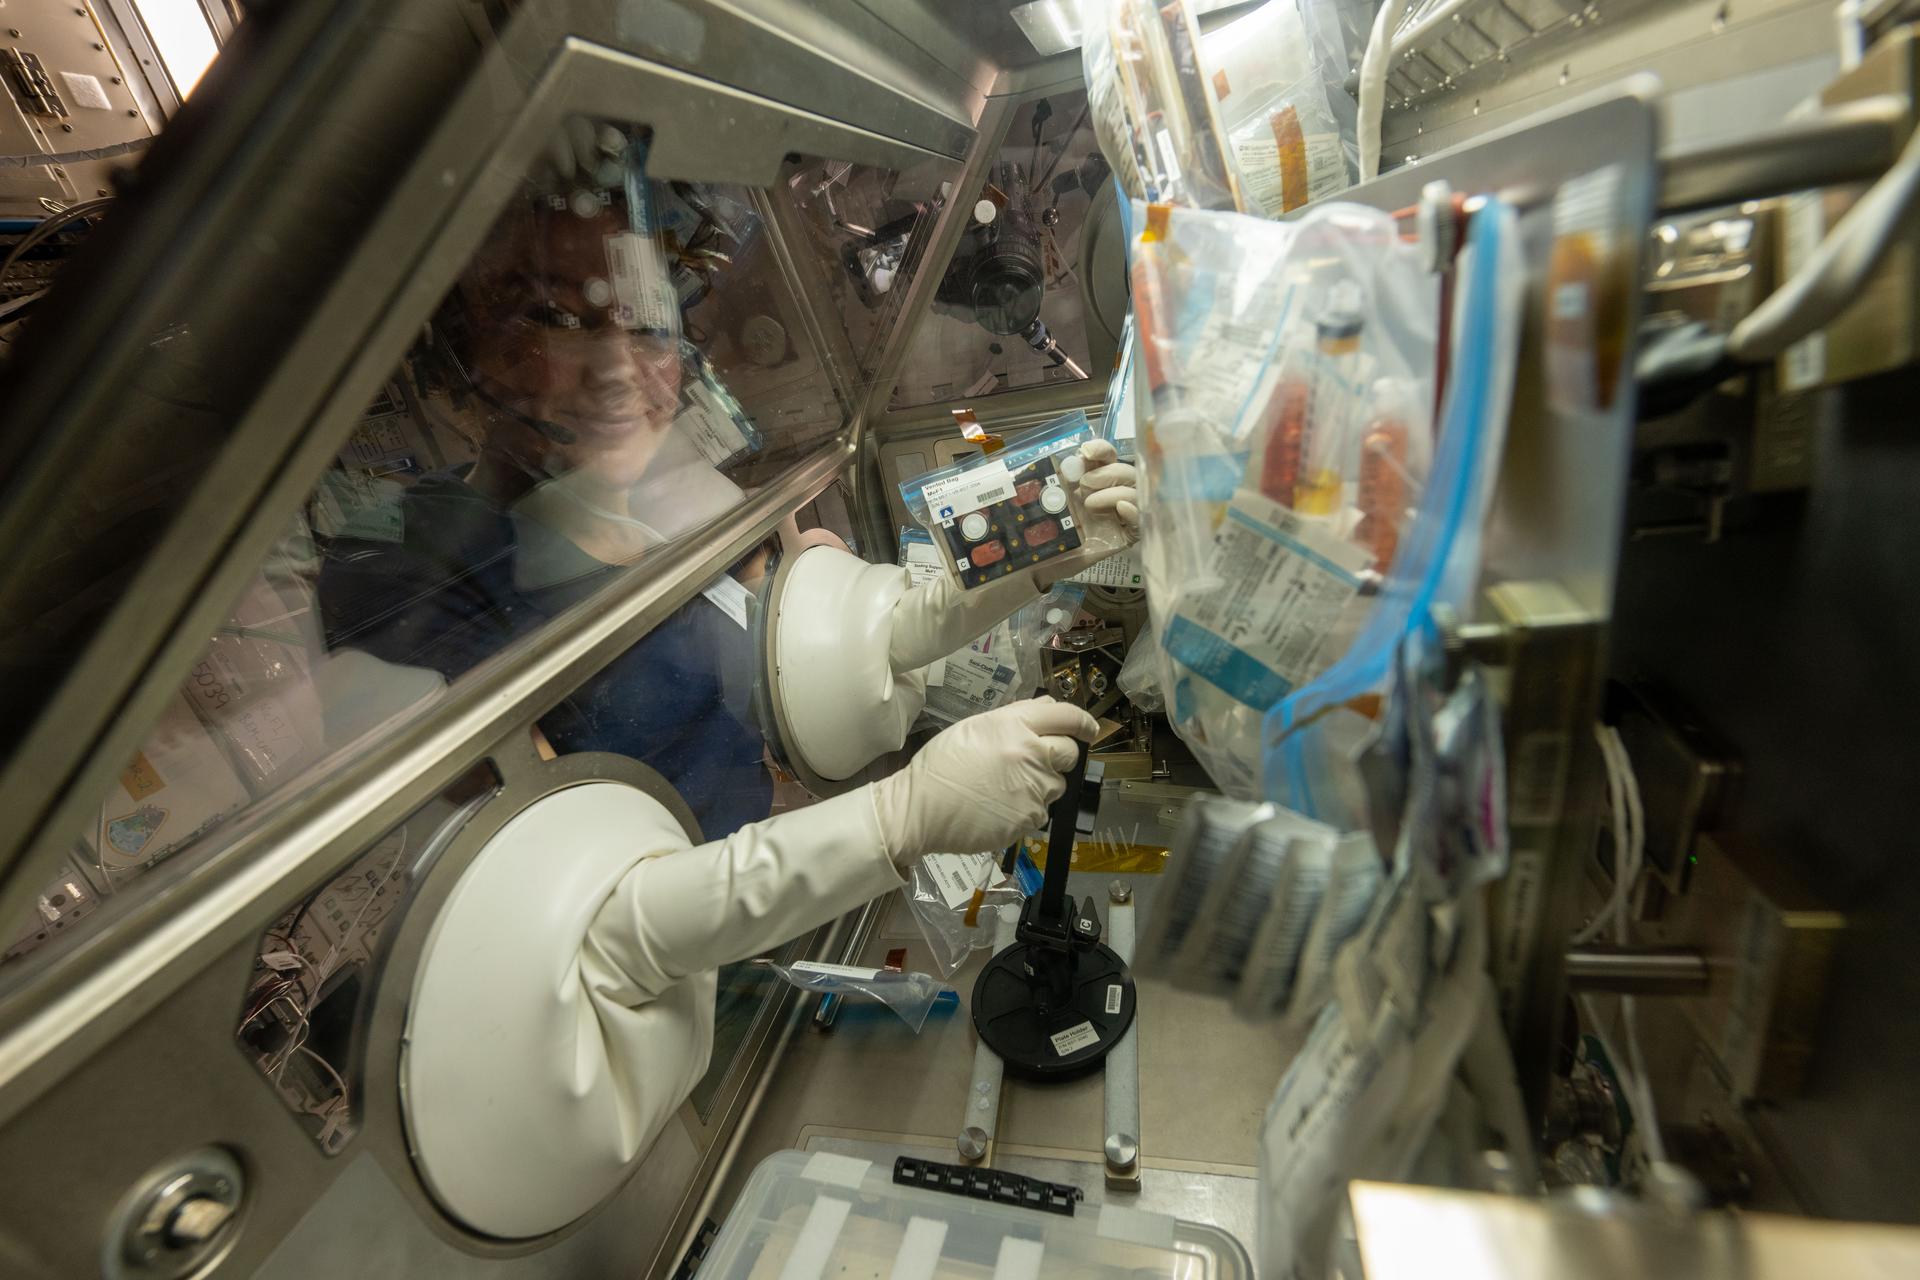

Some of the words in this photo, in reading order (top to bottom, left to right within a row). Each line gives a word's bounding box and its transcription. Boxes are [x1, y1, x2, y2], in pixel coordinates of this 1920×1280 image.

[946, 477, 959, 485] Bag
[1064, 519, 1071, 527] D
[1055, 1034, 1070, 1042] Plate
